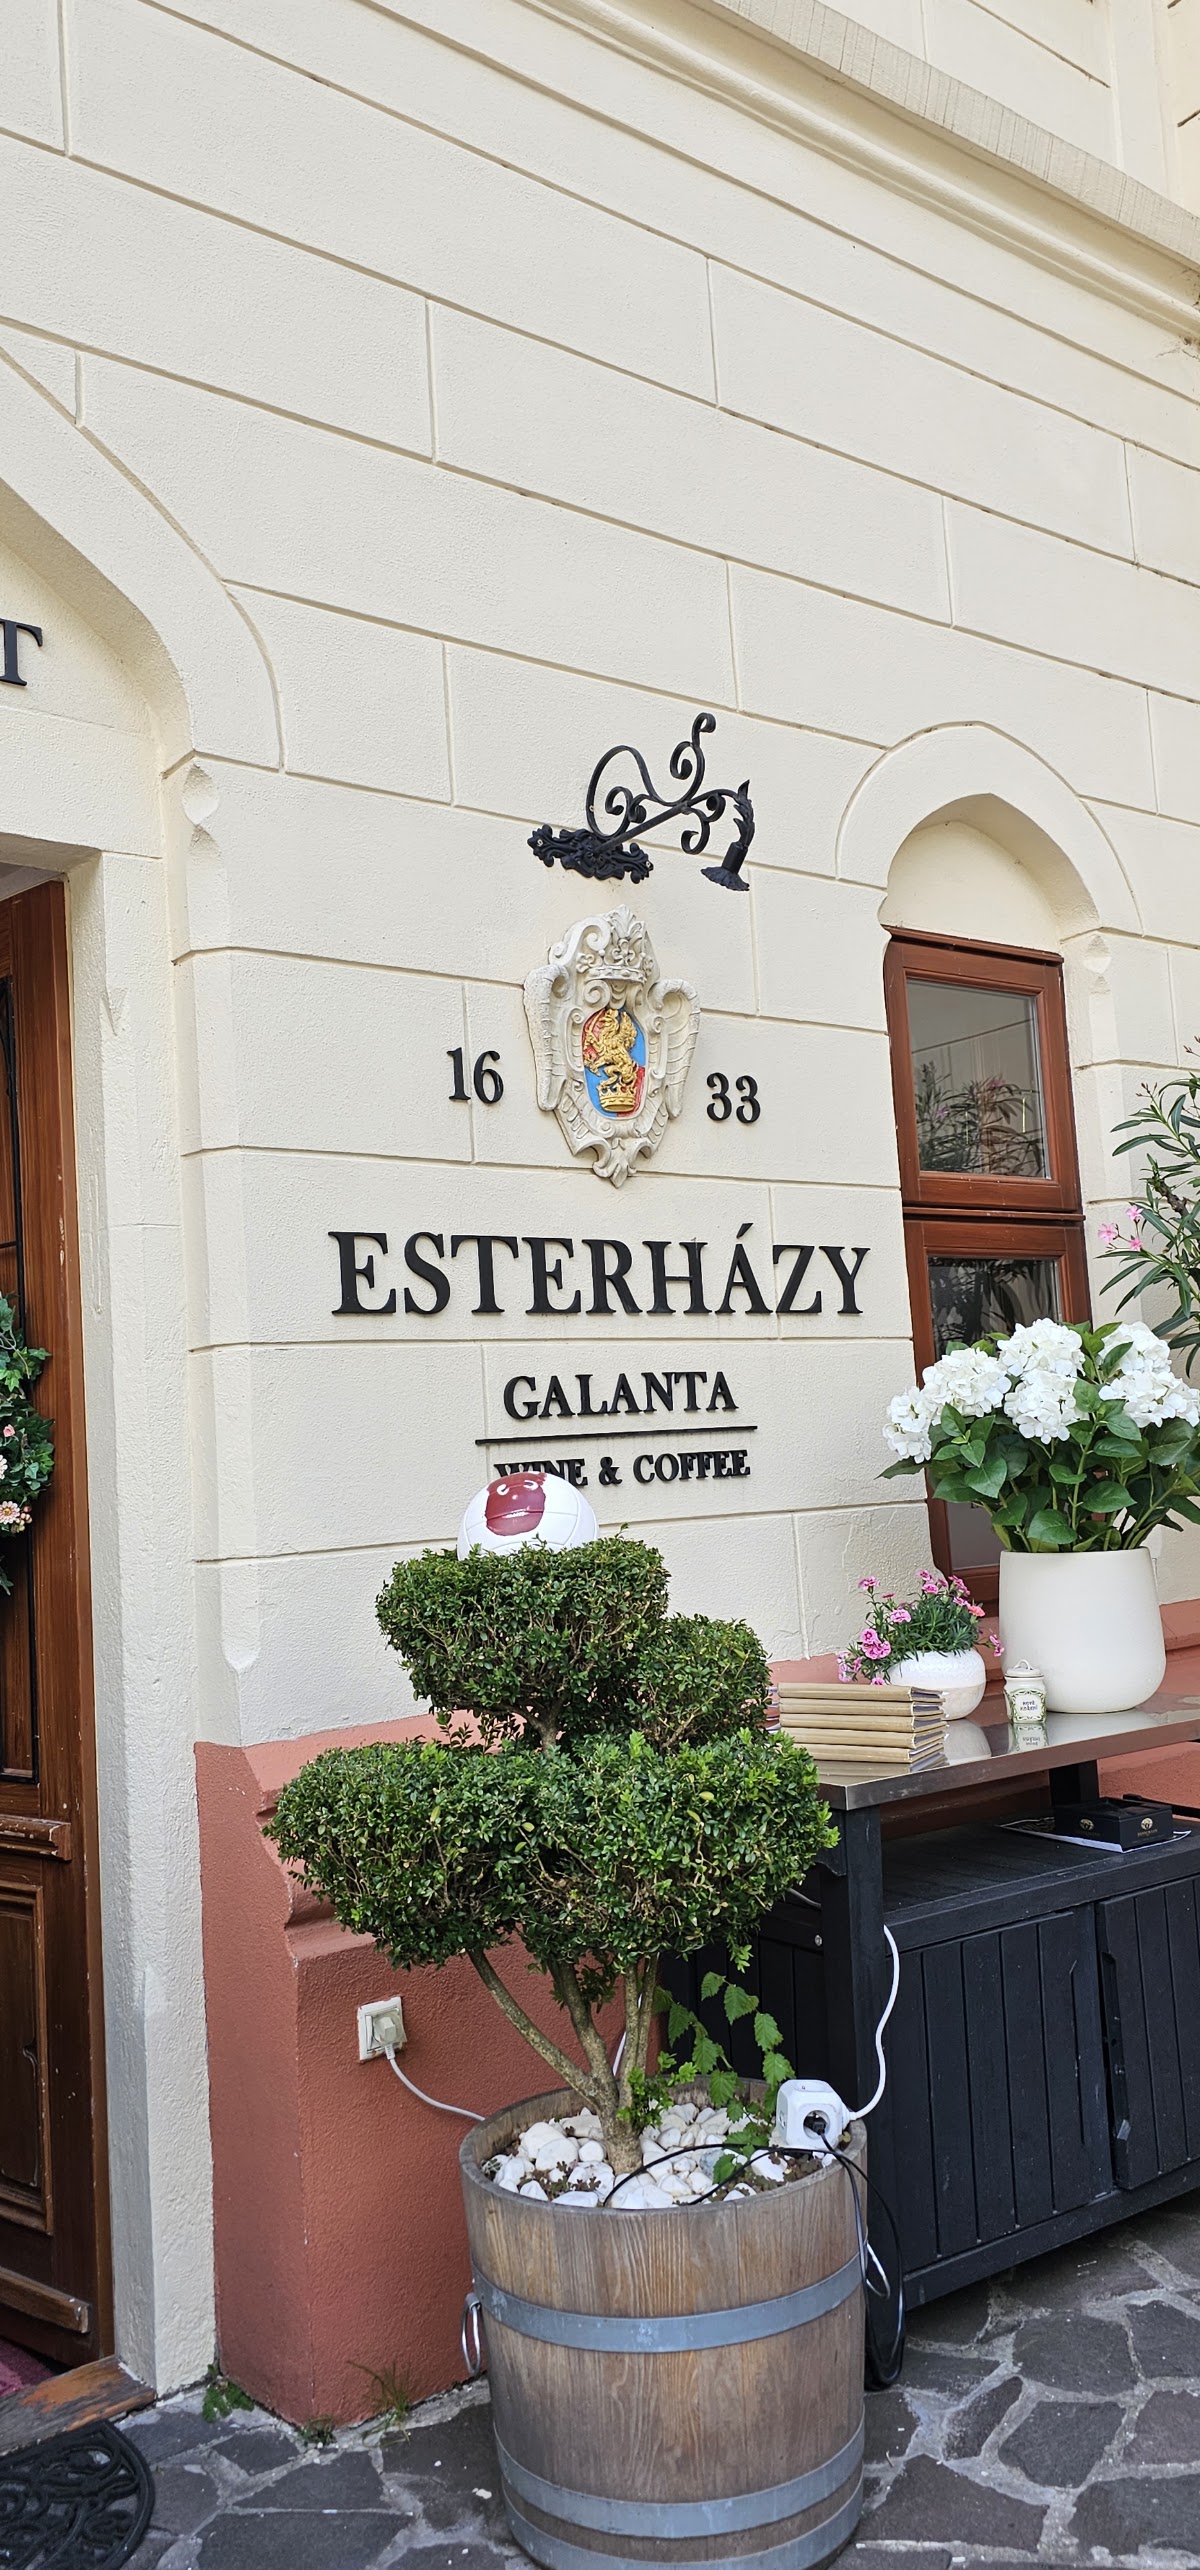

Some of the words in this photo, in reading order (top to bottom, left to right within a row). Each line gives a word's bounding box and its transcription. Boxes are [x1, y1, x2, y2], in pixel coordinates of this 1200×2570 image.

[446, 1046, 504, 1105] 16
[706, 1072, 761, 1125] 33
[328, 1222, 871, 1316] ESTERHÁZY
[503, 1371, 740, 1422] GALANTA
[598, 1456, 623, 1486] &
[632, 1449, 751, 1484] COFFEE
